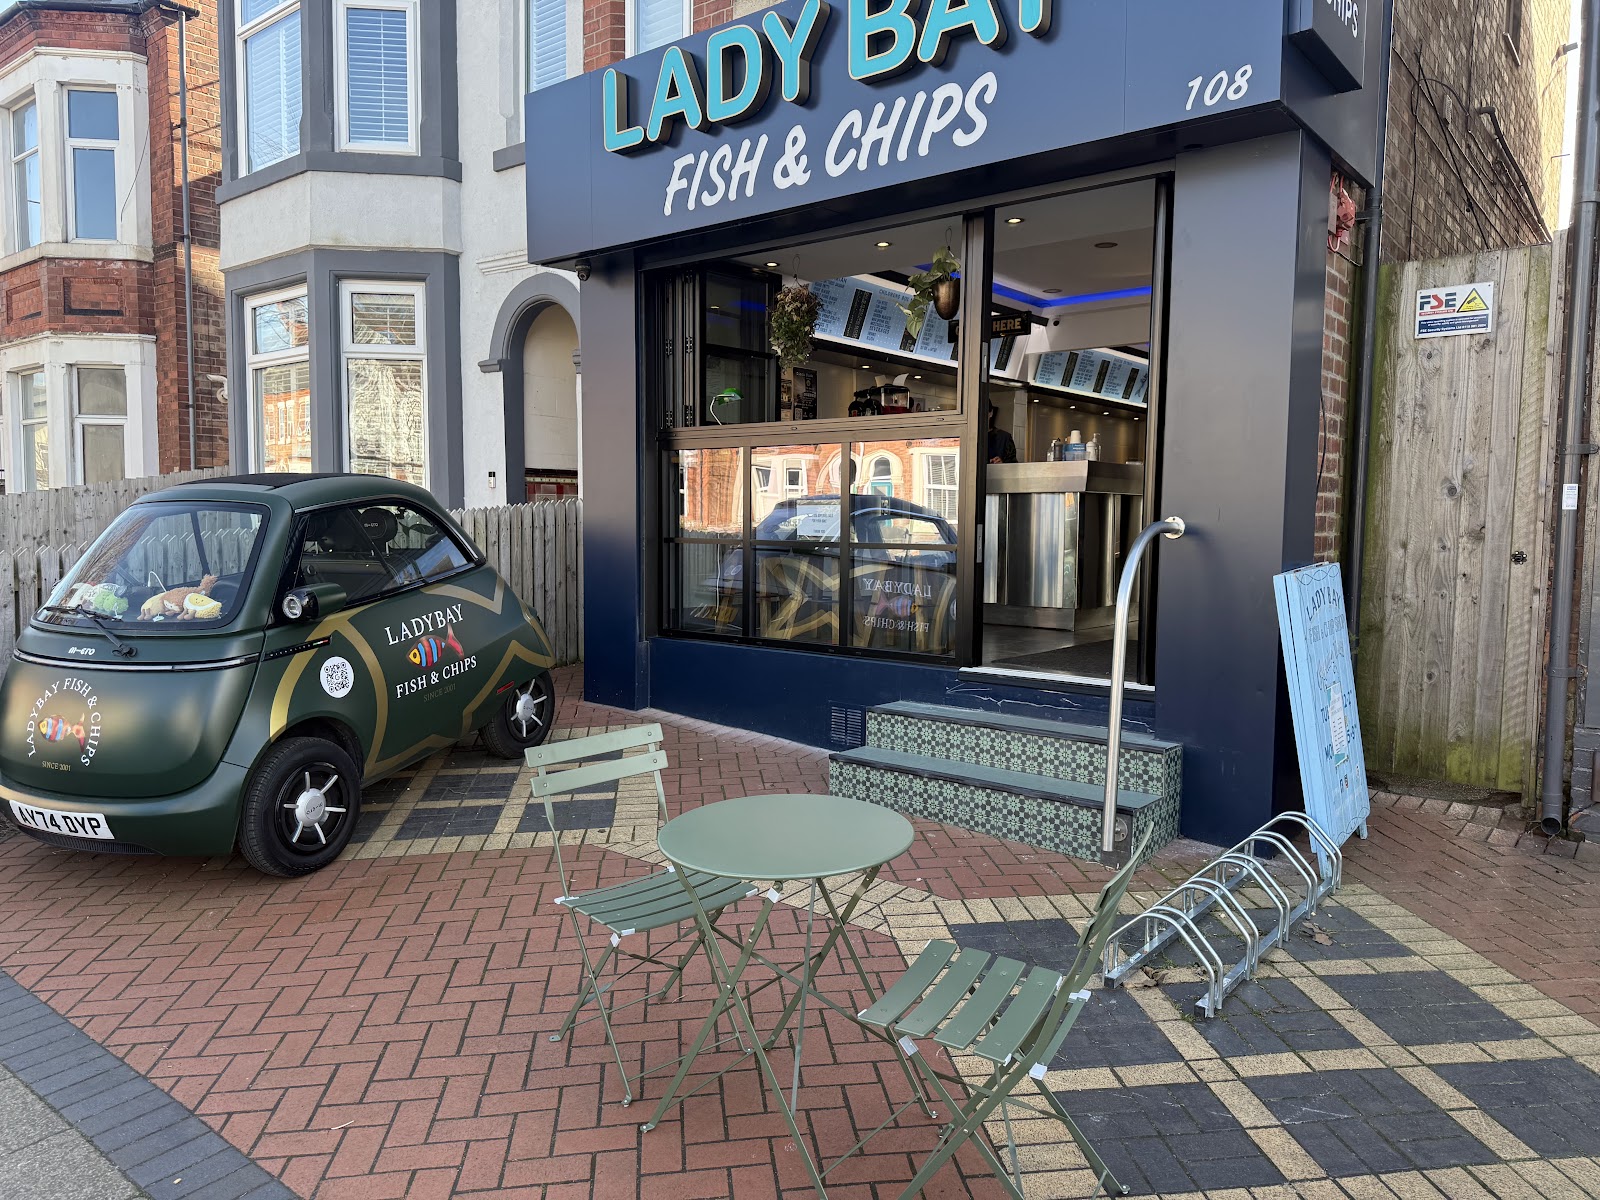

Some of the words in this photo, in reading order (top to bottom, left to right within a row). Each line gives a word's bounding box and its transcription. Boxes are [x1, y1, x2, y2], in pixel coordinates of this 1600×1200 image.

[603, 0, 824, 153] LADY
[1185, 64, 1252, 111] 108
[663, 134, 769, 216] FISH
[772, 124, 812, 190] &
[824, 71, 998, 178] CHIPS
[1420, 292, 1456, 311] FSE
[993, 317, 1022, 332] HERE
[1306, 586, 1326, 621] LADY
[384, 604, 464, 646] LADYBAY
[63, 678, 92, 697] FISH
[395, 674, 428, 699] FISH
[431, 671, 440, 685] &
[442, 655, 477, 680] CHIPS
[87, 695, 98, 710] &
[423, 688, 444, 702] SINCE
[80, 711, 101, 767] CHIPS
[42, 760, 58, 769] SINCE
[18, 806, 62, 832] AY74
[62, 815, 101, 836] DYP
